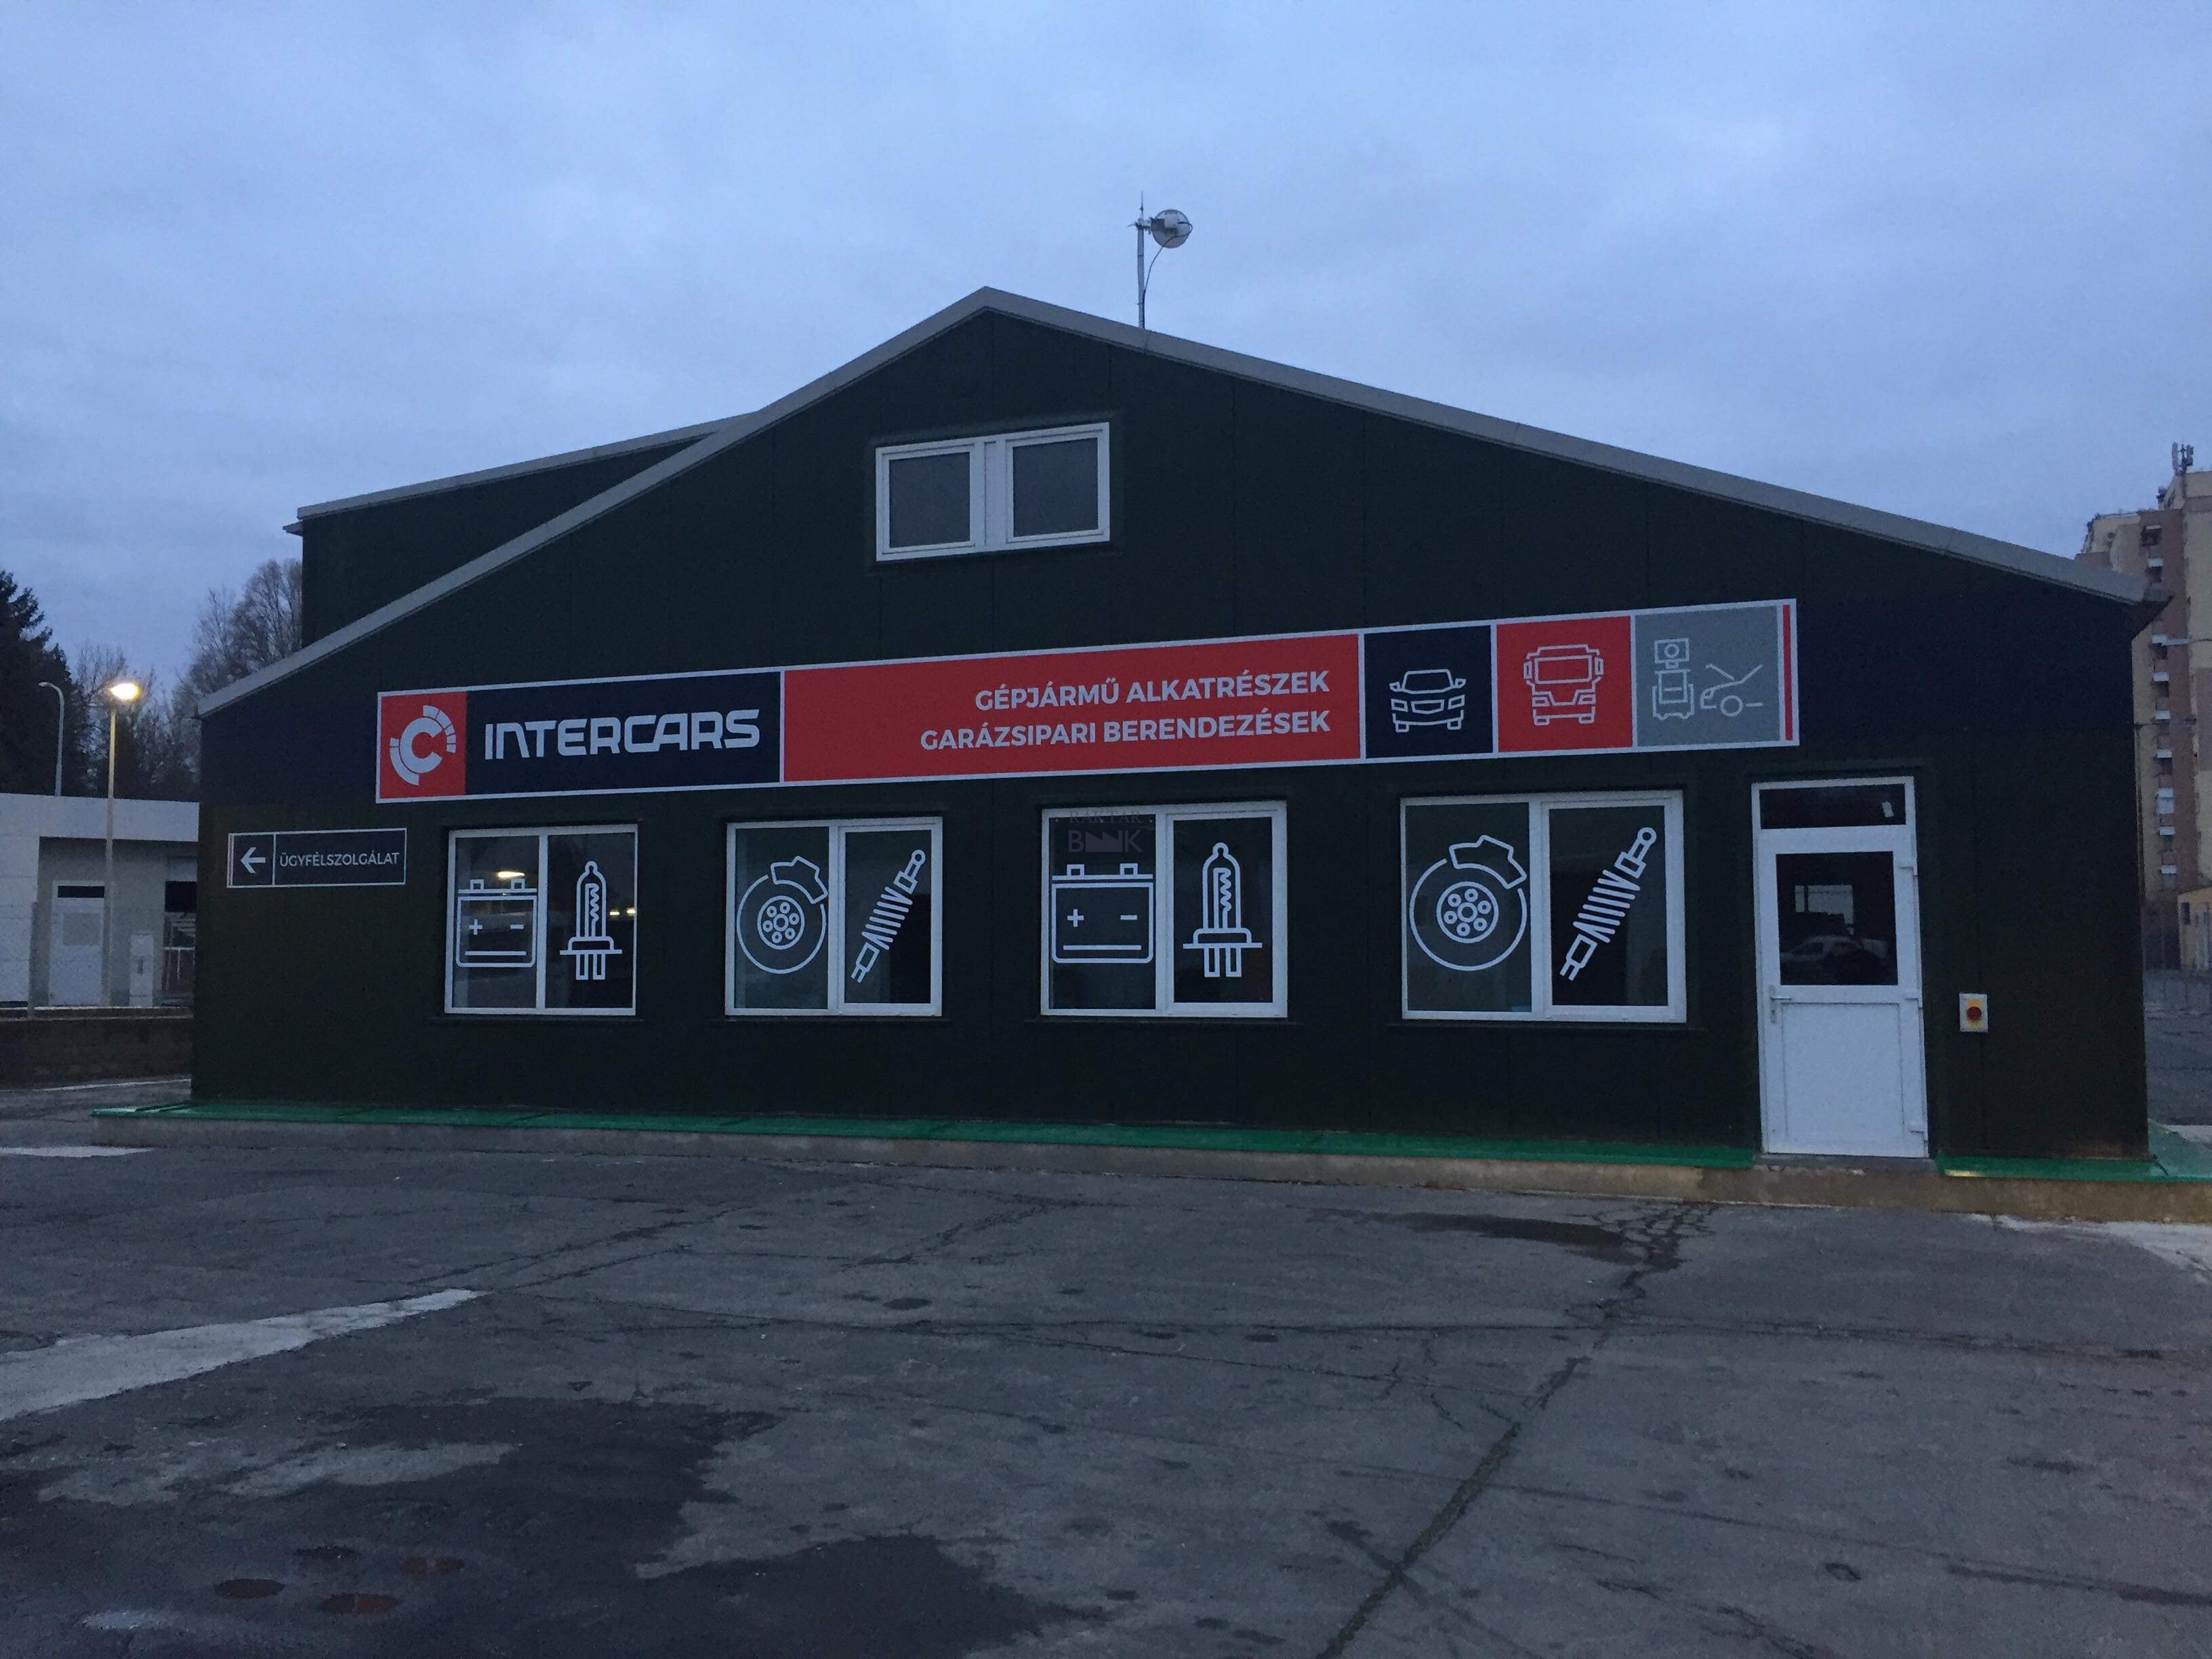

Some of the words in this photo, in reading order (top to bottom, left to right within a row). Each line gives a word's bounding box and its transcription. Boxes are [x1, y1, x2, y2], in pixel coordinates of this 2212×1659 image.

[975, 676, 1120, 712] GÉPJÁRMŰ
[1126, 669, 1330, 703] ALKATRÉSZEK
[485, 708, 760, 760] INTERCARS
[920, 721, 1096, 751] GARÁZSIPARI
[1103, 708, 1331, 743] BERENDEZÉSEK
[279, 850, 400, 867] ÜGYFÉLSZOLGÁLAT
